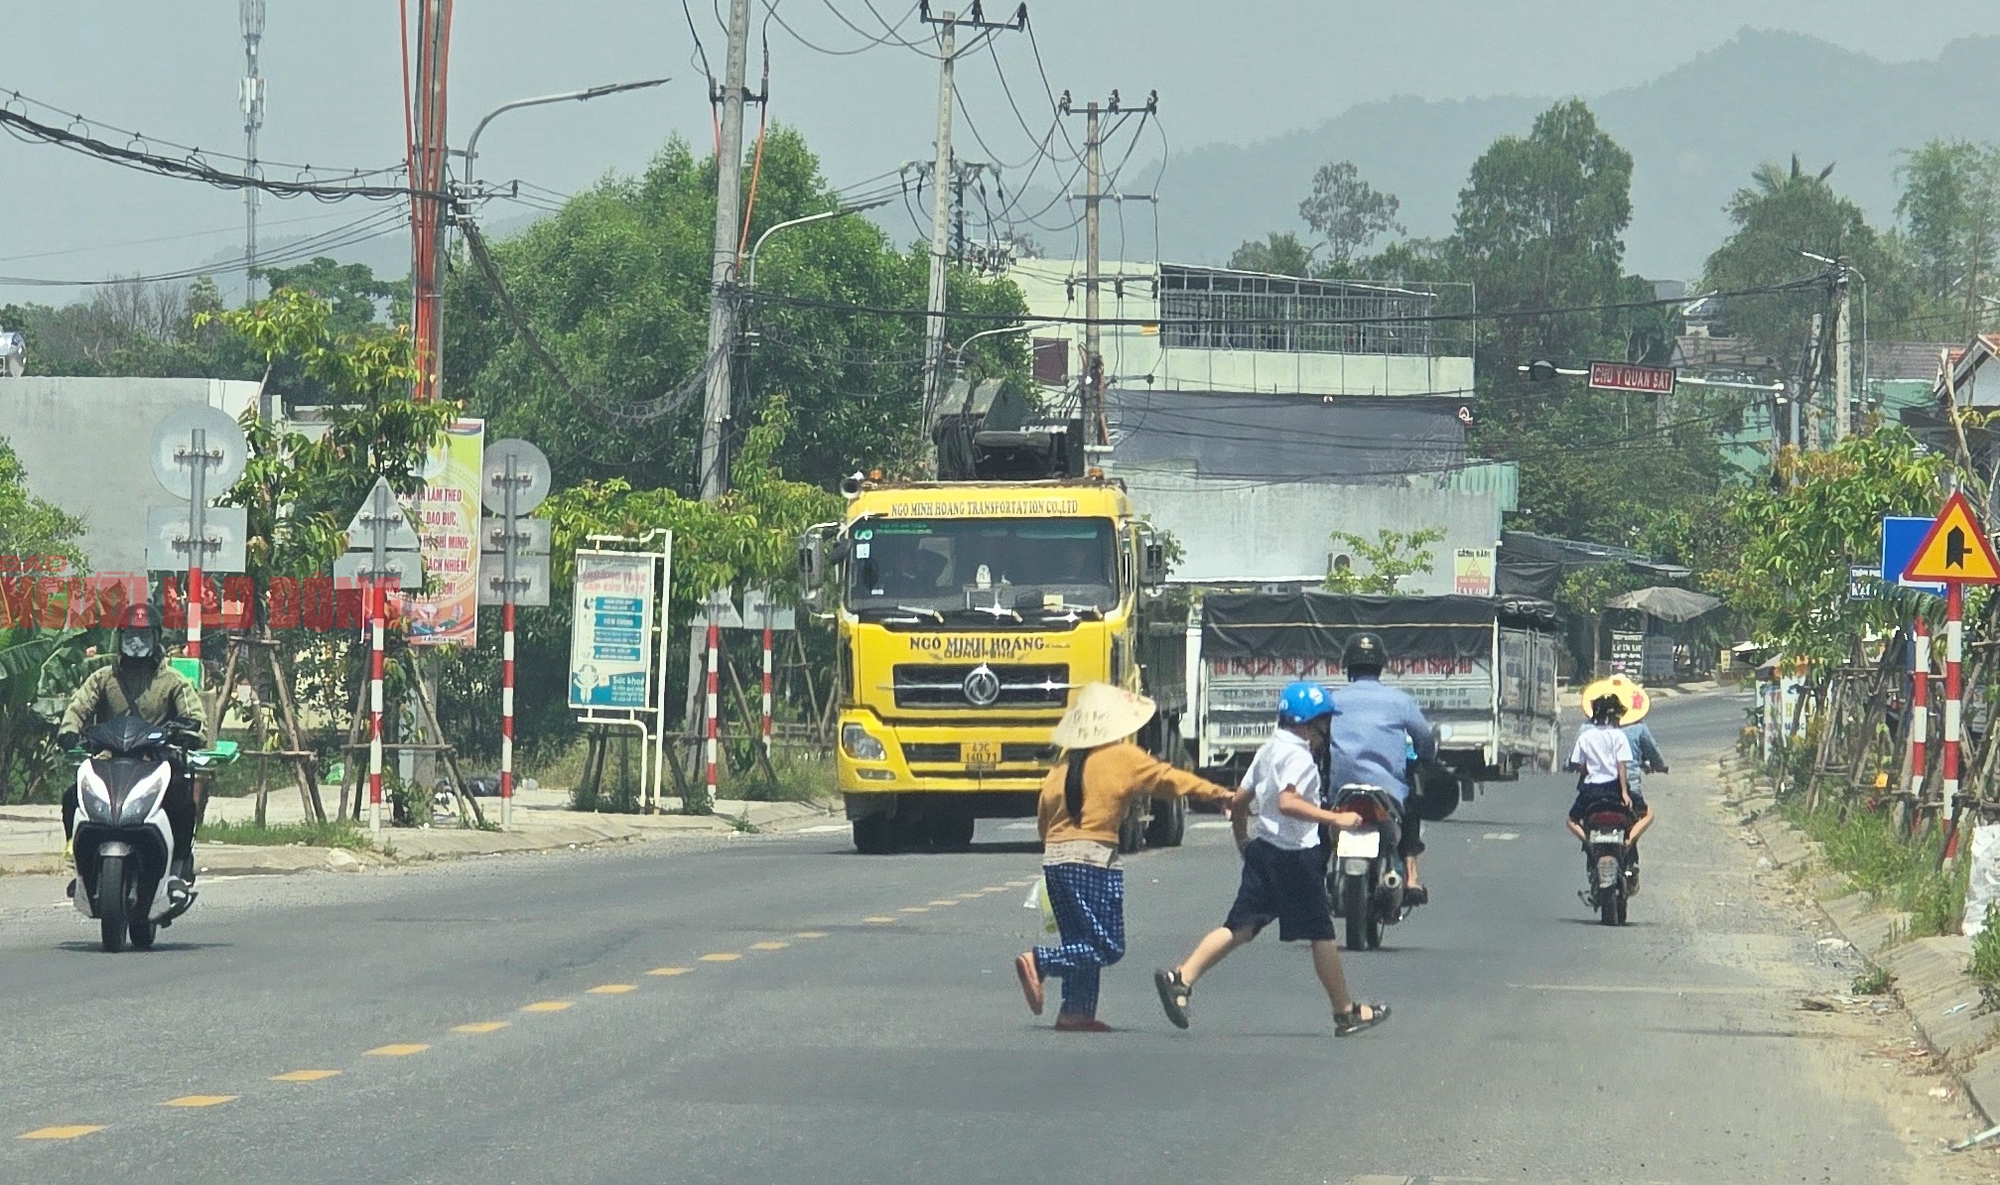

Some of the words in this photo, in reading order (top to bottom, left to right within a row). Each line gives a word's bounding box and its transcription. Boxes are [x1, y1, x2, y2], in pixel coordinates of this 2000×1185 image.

[1624, 370, 1650, 388] QUAN
[444, 488, 462, 502] THEO
[911, 502, 933, 516] MINH
[934, 502, 965, 516] HOANG
[967, 500, 1043, 515] TRANSPORTATION
[946, 637, 986, 653] MINH
